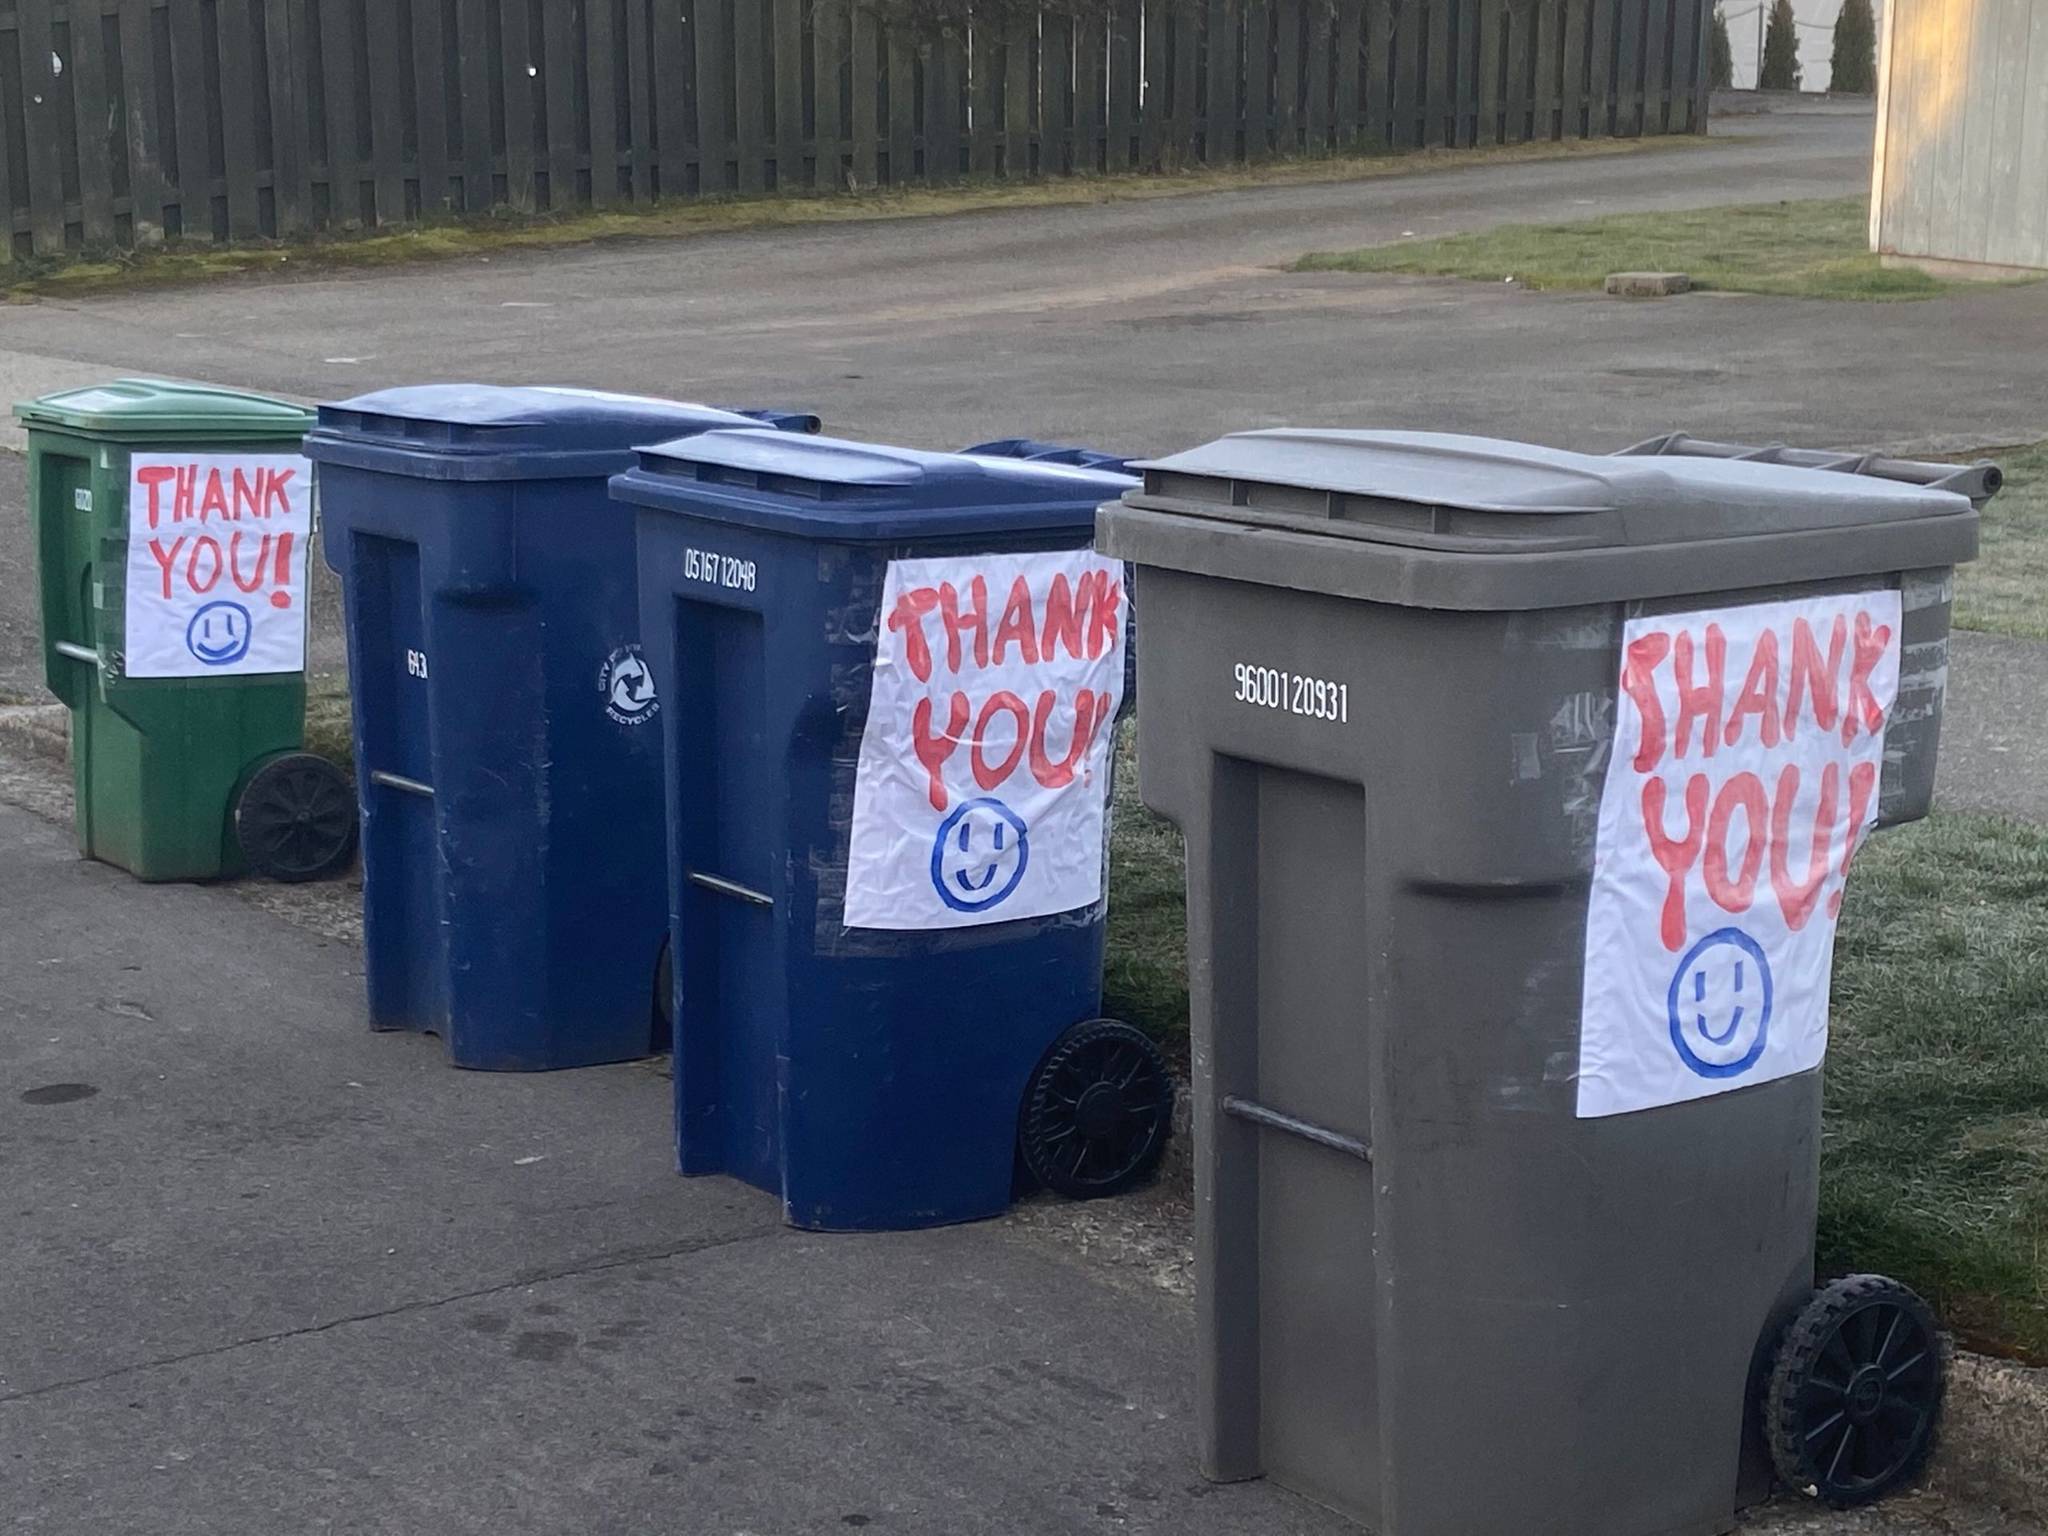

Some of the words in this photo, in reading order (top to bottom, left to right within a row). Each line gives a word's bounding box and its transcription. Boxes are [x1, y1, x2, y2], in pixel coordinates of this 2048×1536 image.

[137, 464, 296, 530] THANK
[148, 531, 294, 609] YOU!
[888, 569, 1120, 683] THANK
[1234, 663, 1347, 723] 9600120931
[1622, 611, 1890, 773] THANK
[912, 689, 1112, 812] YOU!
[1641, 762, 1875, 952] YOU!
